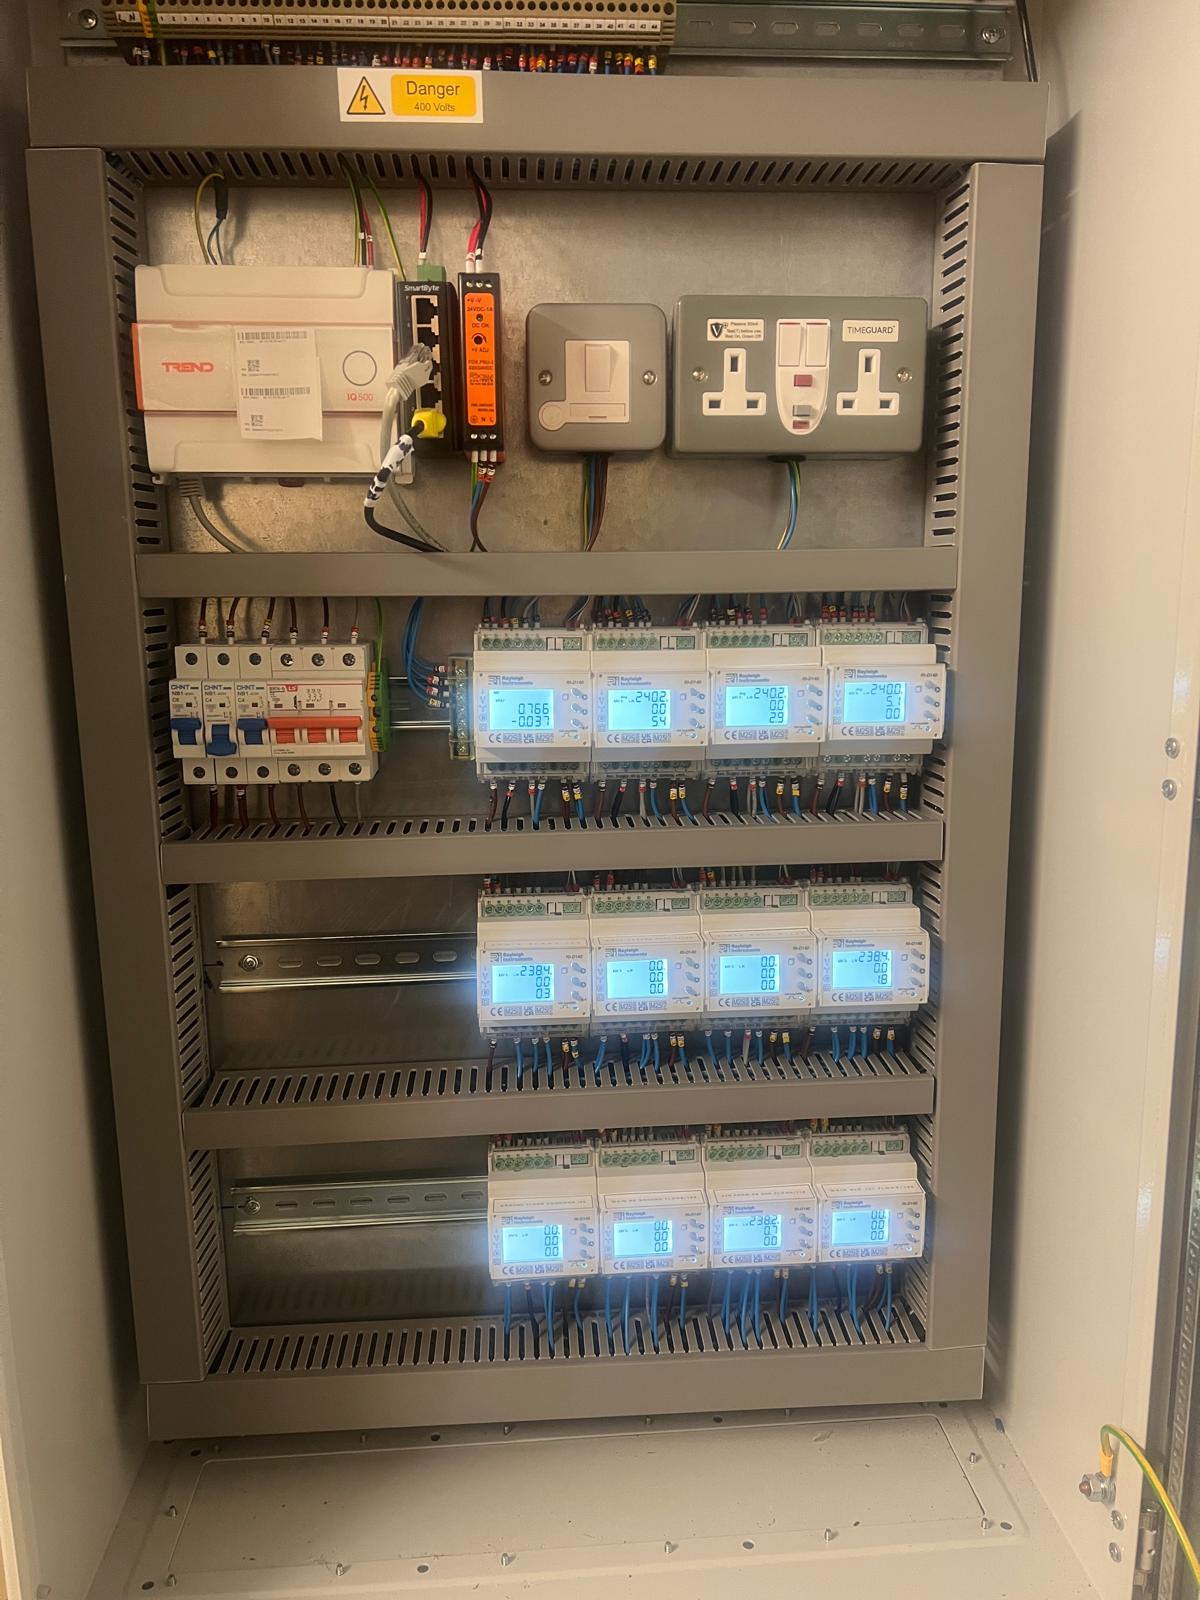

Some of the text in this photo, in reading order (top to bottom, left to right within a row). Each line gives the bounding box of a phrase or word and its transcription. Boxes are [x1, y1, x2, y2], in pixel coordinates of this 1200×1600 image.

[406, 81, 461, 99] Danger
[414, 102, 456, 112] 400 Volts
[404, 285, 440, 293] SmartByte
[847, 326, 893, 334] TIMEGUARD
[161, 362, 214, 373] TREND
[754, 687, 784, 699] 240.2
[870, 683, 901, 695] 240.0
[636, 691, 666, 703] 240.2
[886, 696, 901, 707] 5.1
[518, 703, 550, 715] 0.766
[652, 703, 666, 715] 0.0
[769, 700, 784, 711] 0.0
[769, 712, 784, 724] 2.9
[886, 708, 900, 720] 0.0
[511, 715, 550, 727] -0.037
[652, 715, 666, 727] 5.4
[761, 956, 775, 967] 0.0
[859, 951, 888, 962] 238.4
[520, 965, 550, 976] 238.4
[649, 960, 663, 971] 0.0
[874, 962, 888, 974] 0.0
[649, 972, 664, 983] 0.0
[761, 967, 775, 979] 0.0
[536, 976, 550, 987] 0.0
[761, 979, 775, 991] 0.0
[878, 974, 888, 985] 1.8
[536, 988, 550, 999] 0.3
[650, 983, 664, 994] 0.0
[654, 1221, 668, 1231] 0.0
[749, 1215, 778, 1226] 238.2
[871, 1220, 885, 1230] 0.0
[544, 1225, 558, 1236] 0.0
[654, 1231, 668, 1241] 0.0
[764, 1225, 778, 1236] 0.7
[870, 1230, 884, 1241] 0.0
[544, 1235, 559, 1246] 0.0
[763, 1236, 778, 1246] 0.0
[545, 1246, 559, 1257] 0.0
[654, 1241, 668, 1252] 0.0
